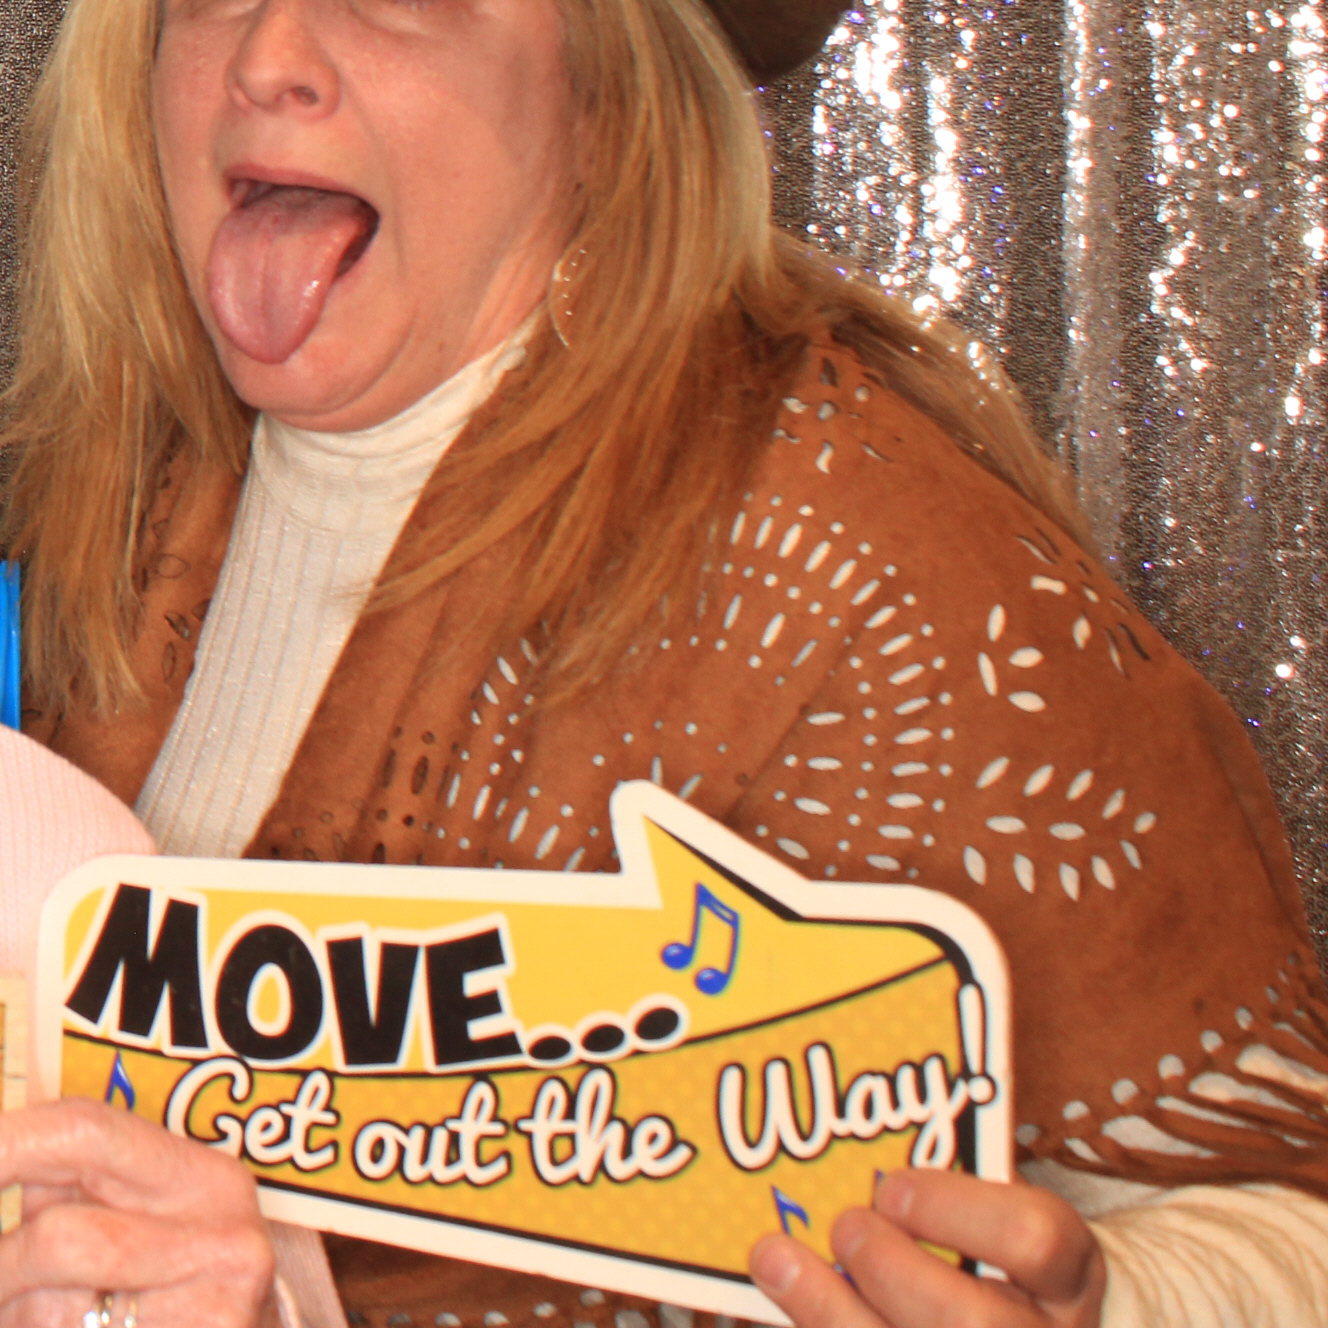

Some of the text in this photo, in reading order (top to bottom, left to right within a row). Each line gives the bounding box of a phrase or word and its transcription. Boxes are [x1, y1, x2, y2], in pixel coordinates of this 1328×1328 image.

[64, 883, 681, 1068] MOVE...
[166, 981, 998, 1185] Get out the Way!
